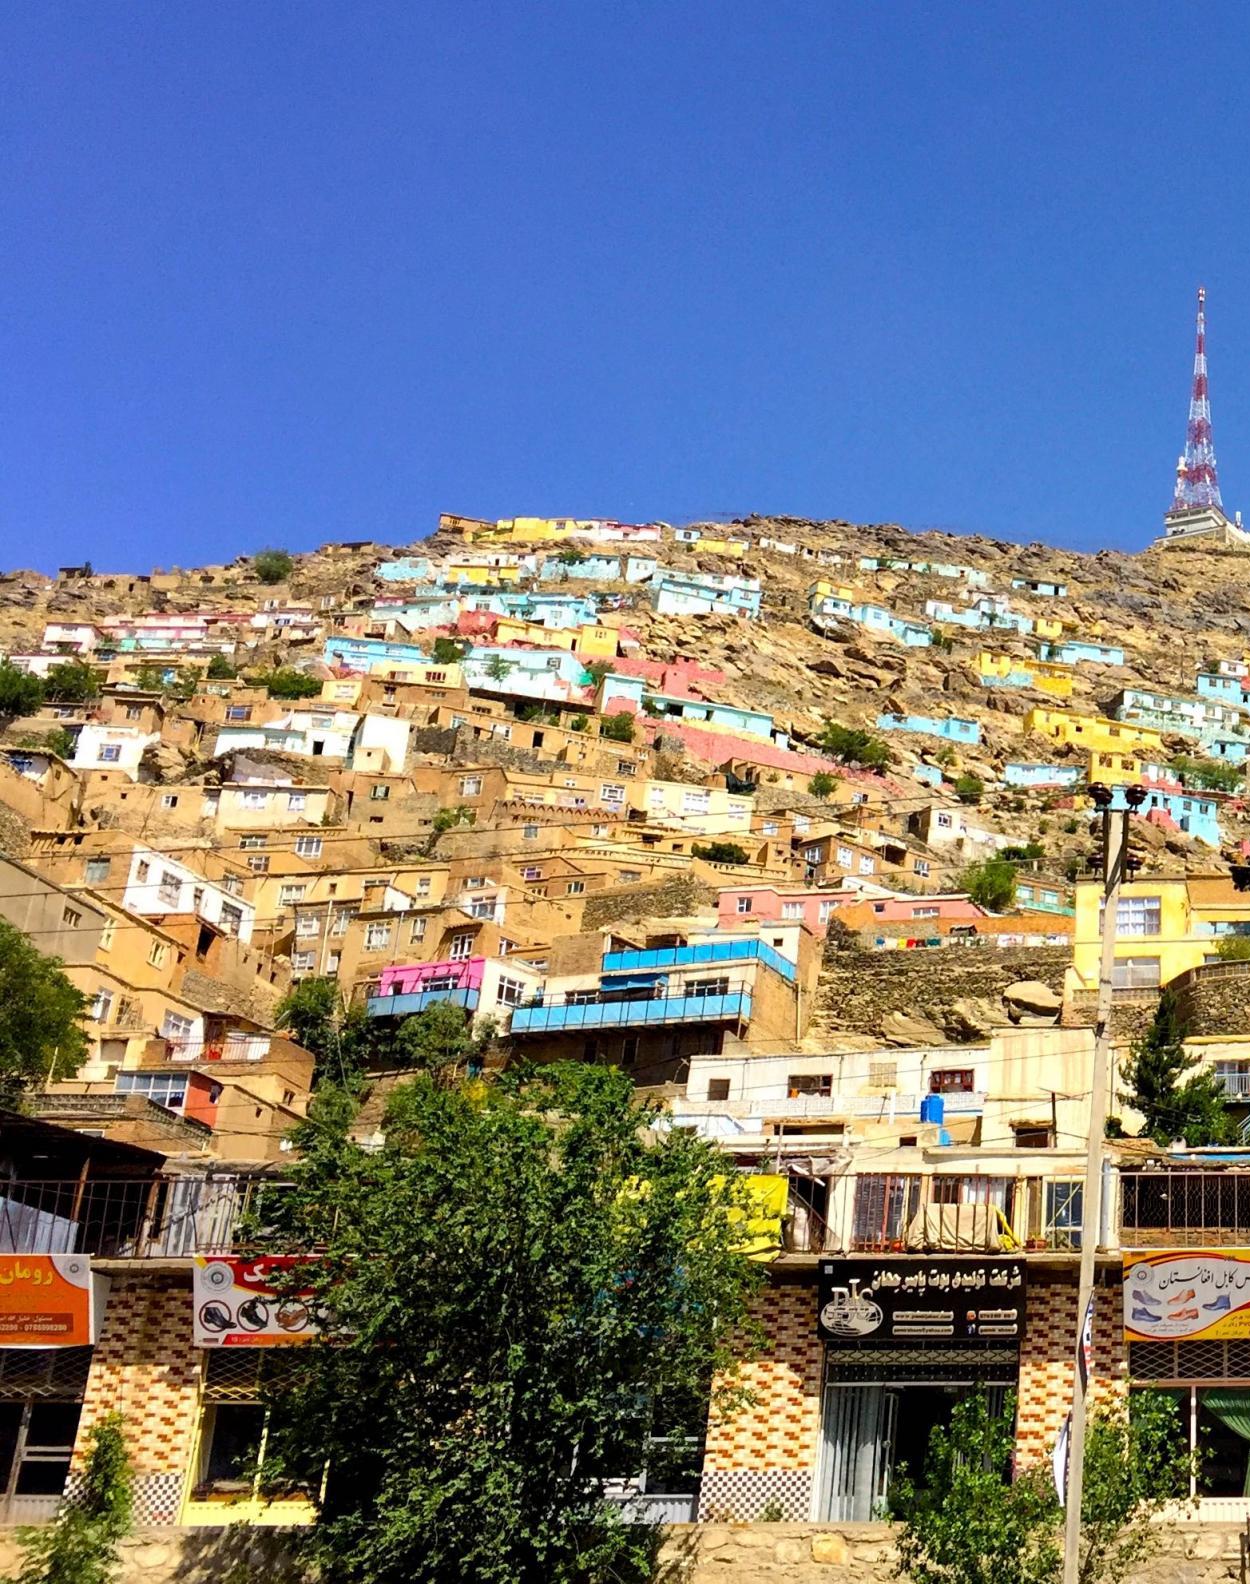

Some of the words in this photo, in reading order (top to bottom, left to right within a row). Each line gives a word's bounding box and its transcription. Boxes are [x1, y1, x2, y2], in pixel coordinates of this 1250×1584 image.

[928, 1268, 951, 1293] بوت
[989, 1265, 1022, 1290] شرکت
[1158, 1265, 1214, 1290] افغانستان
[1215, 1268, 1238, 1289] کابل
